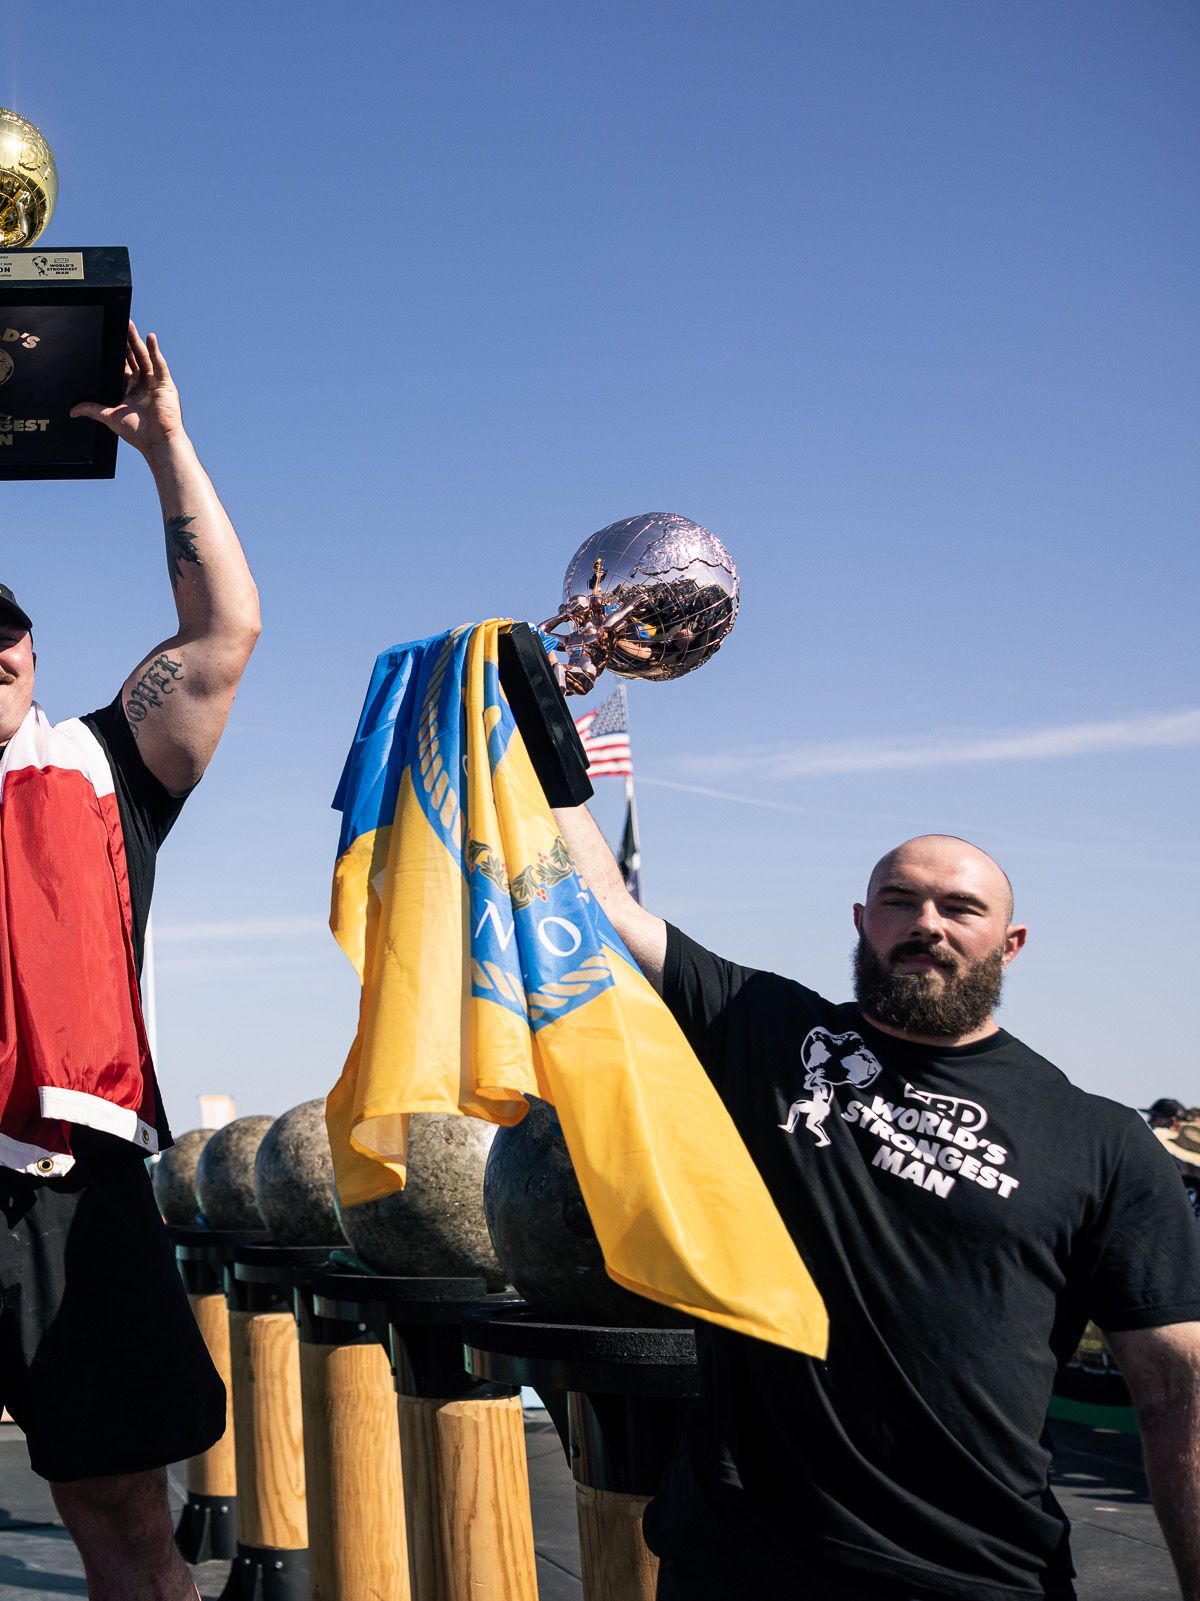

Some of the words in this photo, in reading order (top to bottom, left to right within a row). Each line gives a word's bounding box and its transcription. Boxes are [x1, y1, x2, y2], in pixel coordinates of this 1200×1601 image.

[841, 1100, 1020, 1198] STRONGEST
[871, 1095, 1008, 1165] WORLD'S
[872, 1145, 957, 1199] MAN
